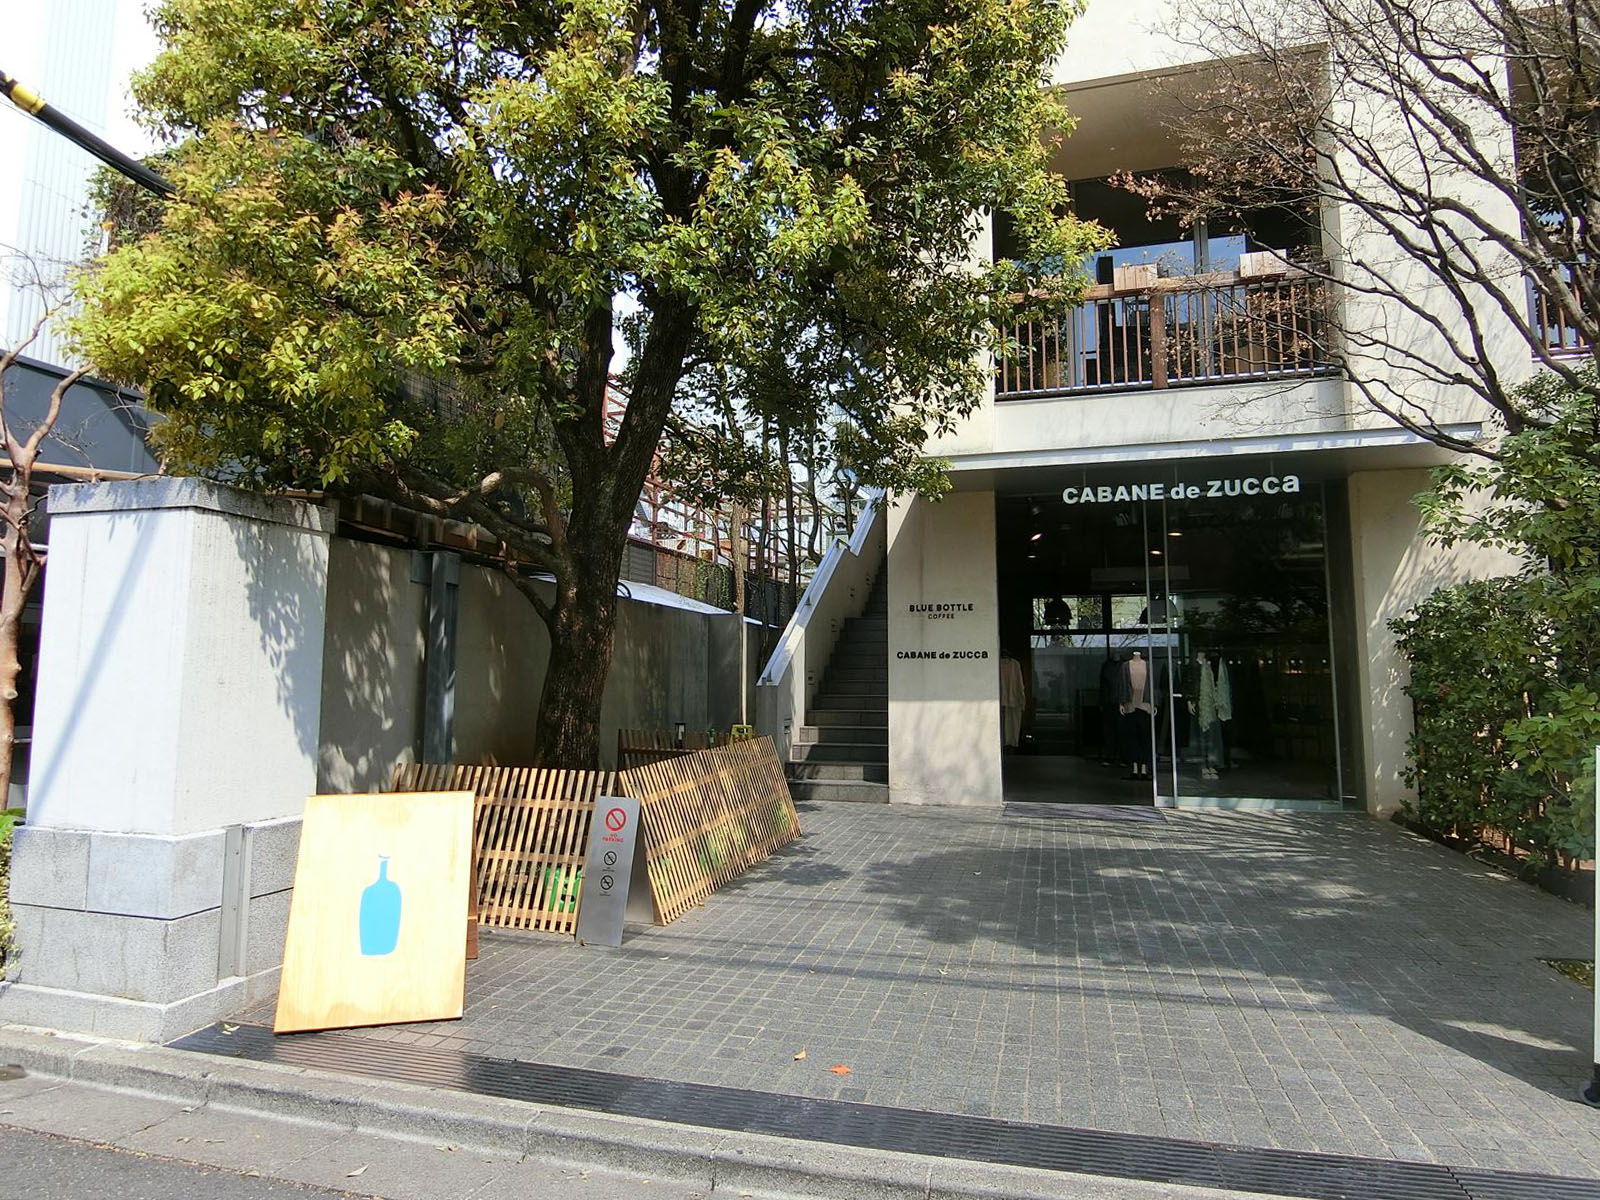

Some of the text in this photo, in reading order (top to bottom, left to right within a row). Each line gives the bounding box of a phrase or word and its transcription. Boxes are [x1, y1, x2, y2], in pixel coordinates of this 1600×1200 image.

[1062, 475, 1300, 505] CABANE de ZUCCa
[909, 603, 974, 612] BLUE BOTTLE
[896, 650, 988, 660] CABANE de ZUCCa
